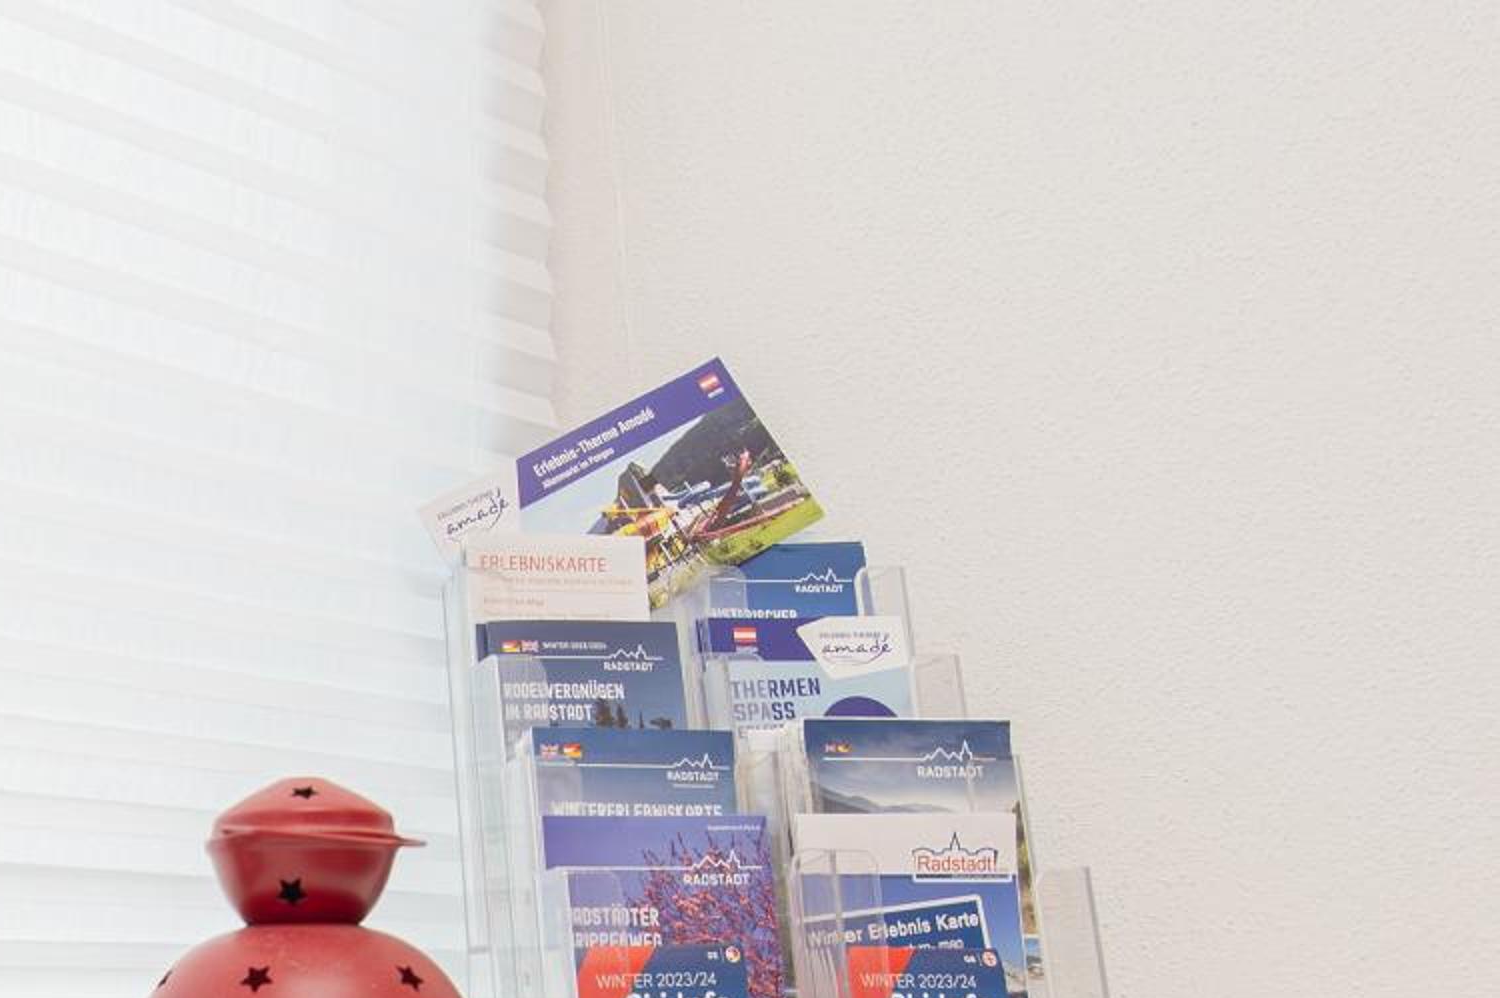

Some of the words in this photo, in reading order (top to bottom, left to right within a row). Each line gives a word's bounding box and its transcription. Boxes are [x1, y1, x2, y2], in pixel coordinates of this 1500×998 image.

[480, 555, 608, 573] ERLEBNISKARTE
[794, 584, 844, 593] RADSTADT
[603, 661, 654, 672] RADSTADT
[731, 676, 821, 700] THERMEN
[734, 701, 796, 722] SPASS
[666, 770, 719, 782] RADSTADT
[916, 765, 984, 779] RADSTADT
[682, 872, 750, 886] RADSTADT
[568, 903, 660, 927] ADSTÄDTER
[868, 916, 931, 940] Erlebnis
[935, 911, 979, 931] Karte
[572, 931, 663, 948] RIPPENWEG
[596, 973, 654, 989] WINTER
[657, 972, 717, 988] 2023/24
[860, 973, 915, 988] WINTER
[919, 973, 977, 989] 2023/24
